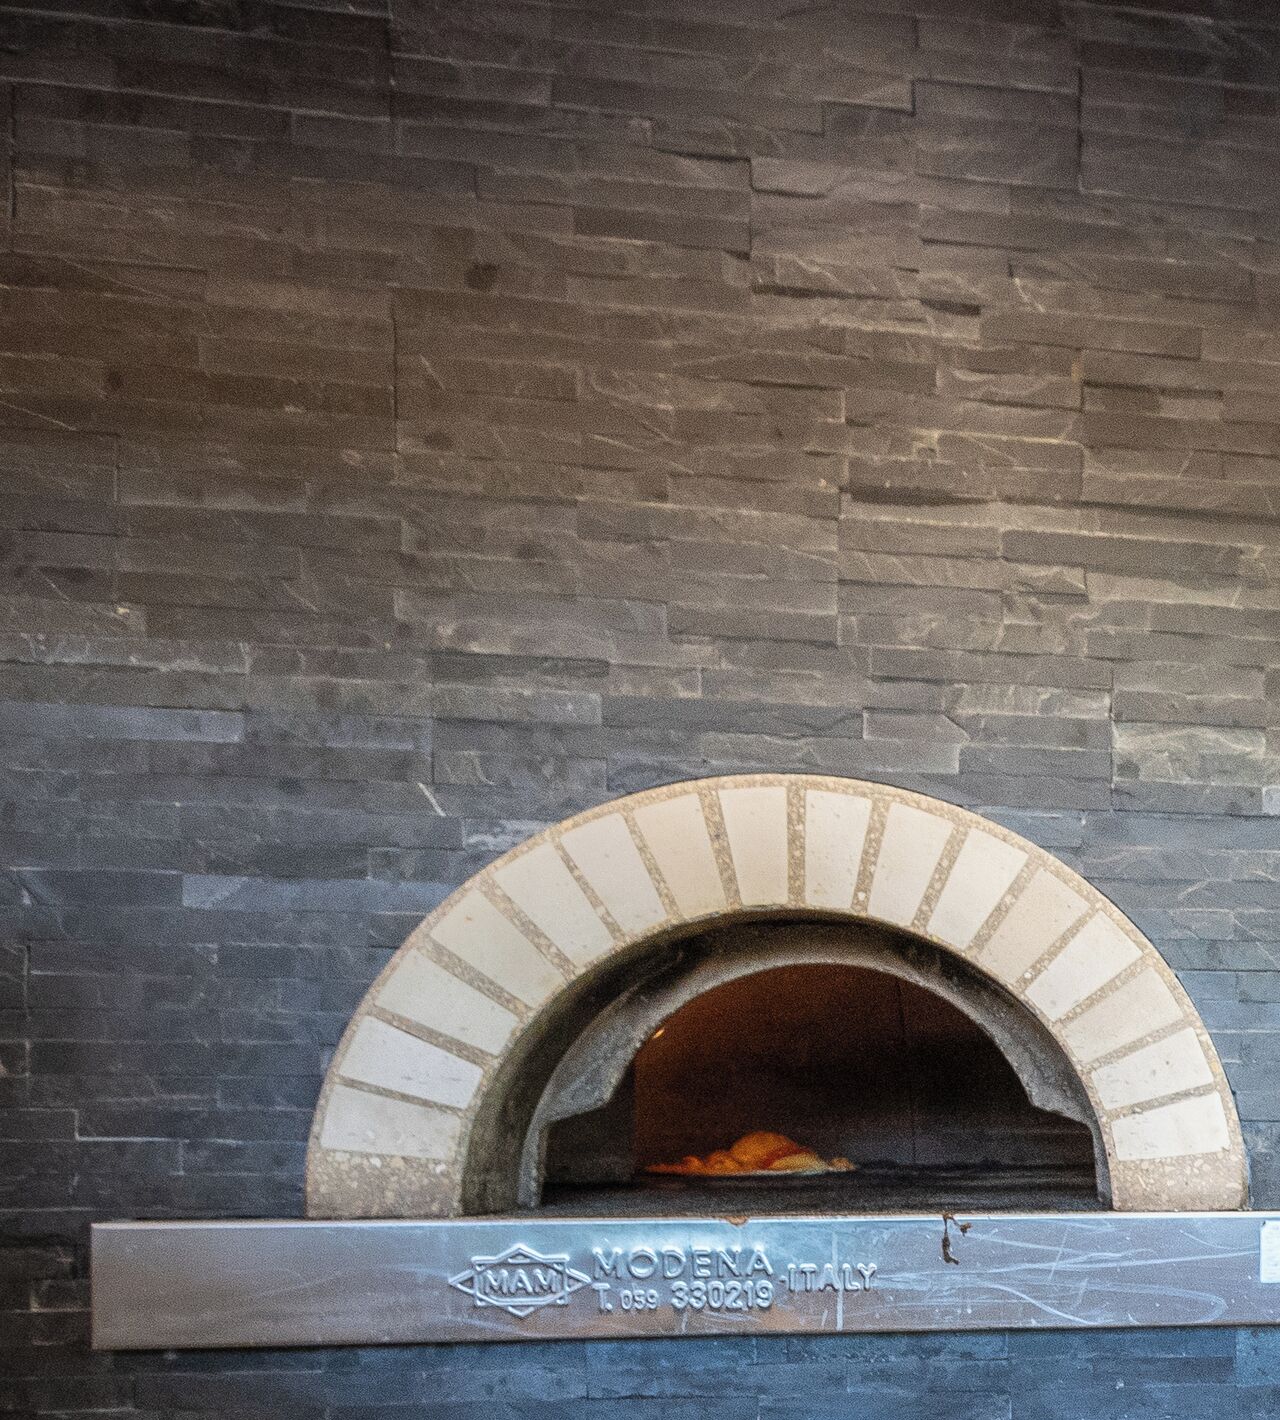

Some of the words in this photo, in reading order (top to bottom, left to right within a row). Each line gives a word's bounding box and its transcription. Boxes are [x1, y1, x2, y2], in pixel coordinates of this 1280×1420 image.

[592, 1246, 775, 1281] MODENA
[483, 1269, 560, 1294] MAM
[620, 1288, 659, 1310] 059
[671, 1279, 775, 1309] 330219
